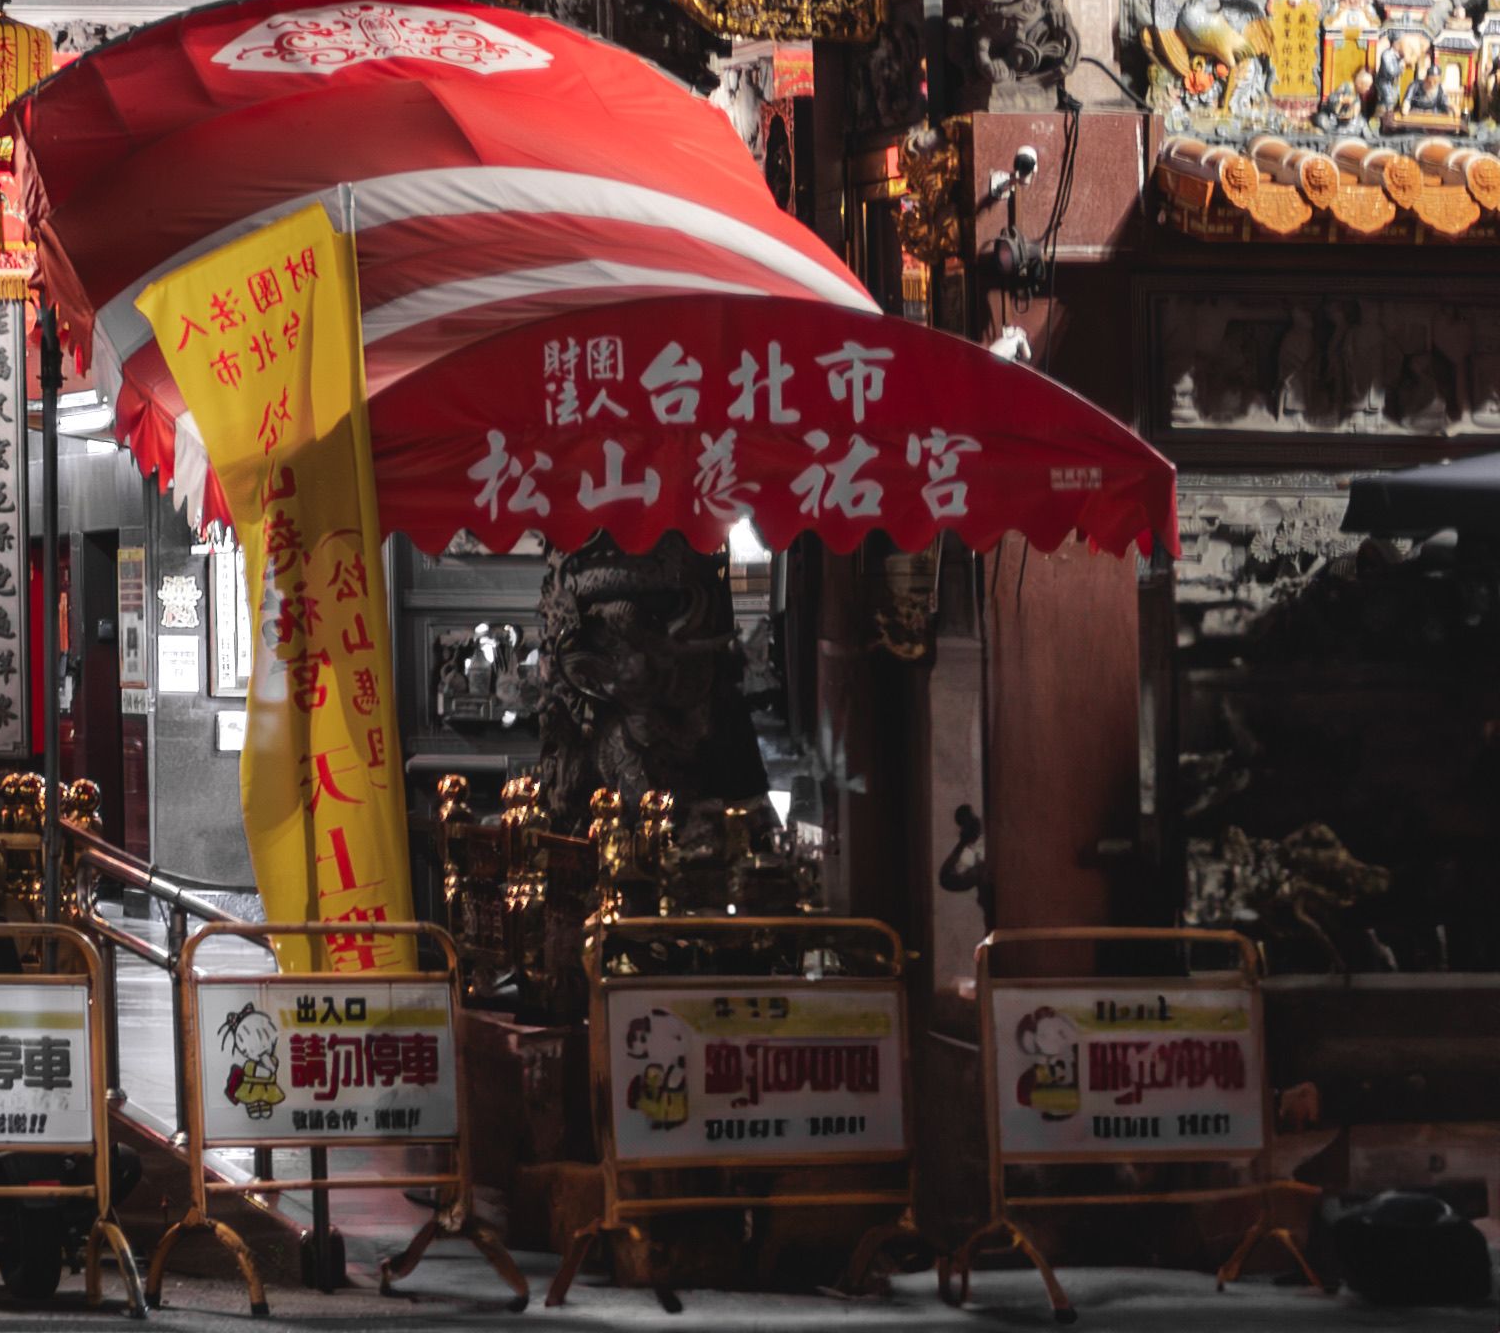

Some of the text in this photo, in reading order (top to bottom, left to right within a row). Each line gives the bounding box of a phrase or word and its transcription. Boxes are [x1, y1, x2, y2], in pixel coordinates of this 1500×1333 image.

[543, 335, 625, 381] 財團
[639, 338, 895, 427] 台北市
[543, 381, 629, 427] 法人
[468, 427, 984, 521] 松山慈祐宮
[296, 995, 367, 1025] 出入口
[289, 1033, 439, 1101] 請勿停車
